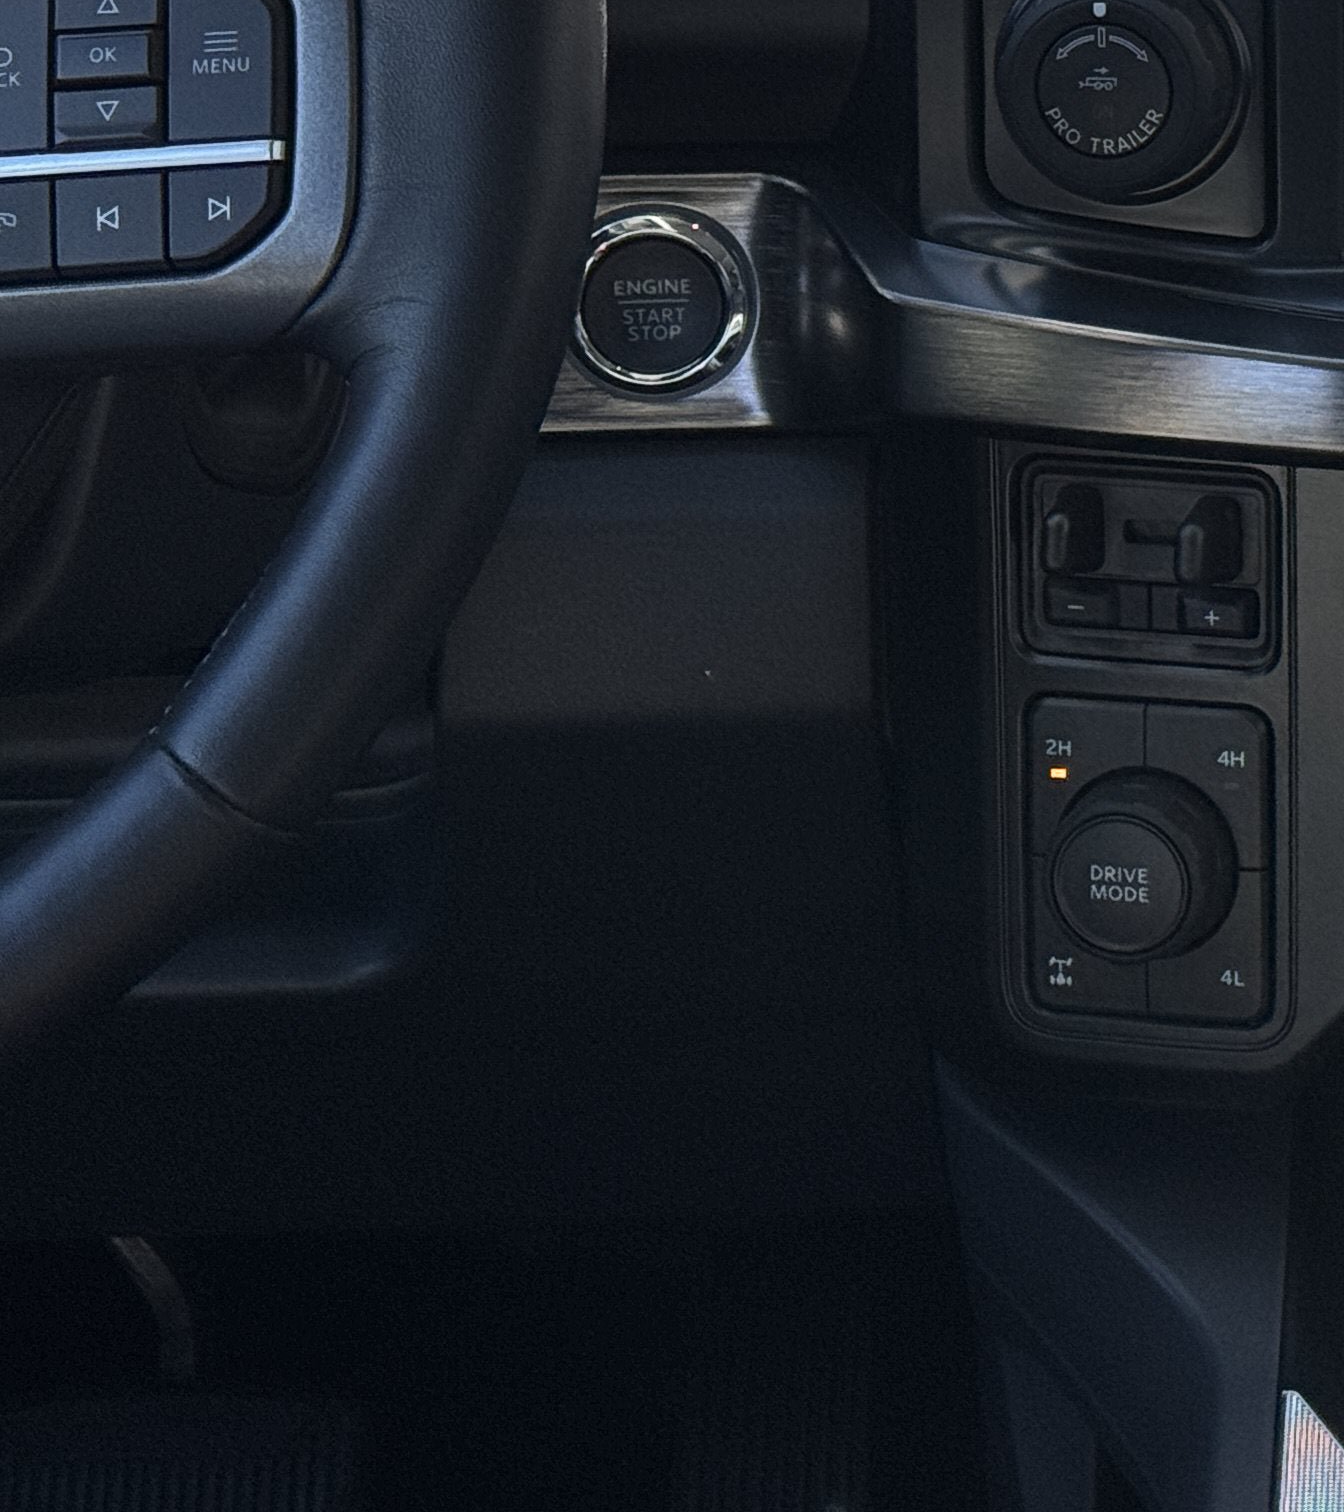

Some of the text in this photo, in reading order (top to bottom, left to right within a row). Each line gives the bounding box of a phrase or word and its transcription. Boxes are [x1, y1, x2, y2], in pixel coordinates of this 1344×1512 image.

[89, 47, 117, 63] OK
[192, 57, 251, 75] MENU
[1044, 105, 1165, 156] PRO TRAILER
[613, 278, 692, 297] ENGINE
[622, 308, 685, 324] START
[626, 323, 682, 341] STOP
[1045, 739, 1072, 757] 2H
[1217, 751, 1246, 768] 4H
[1089, 865, 1149, 885] DRIVE
[1089, 884, 1150, 904] MODE
[1220, 970, 1245, 988] 4L
